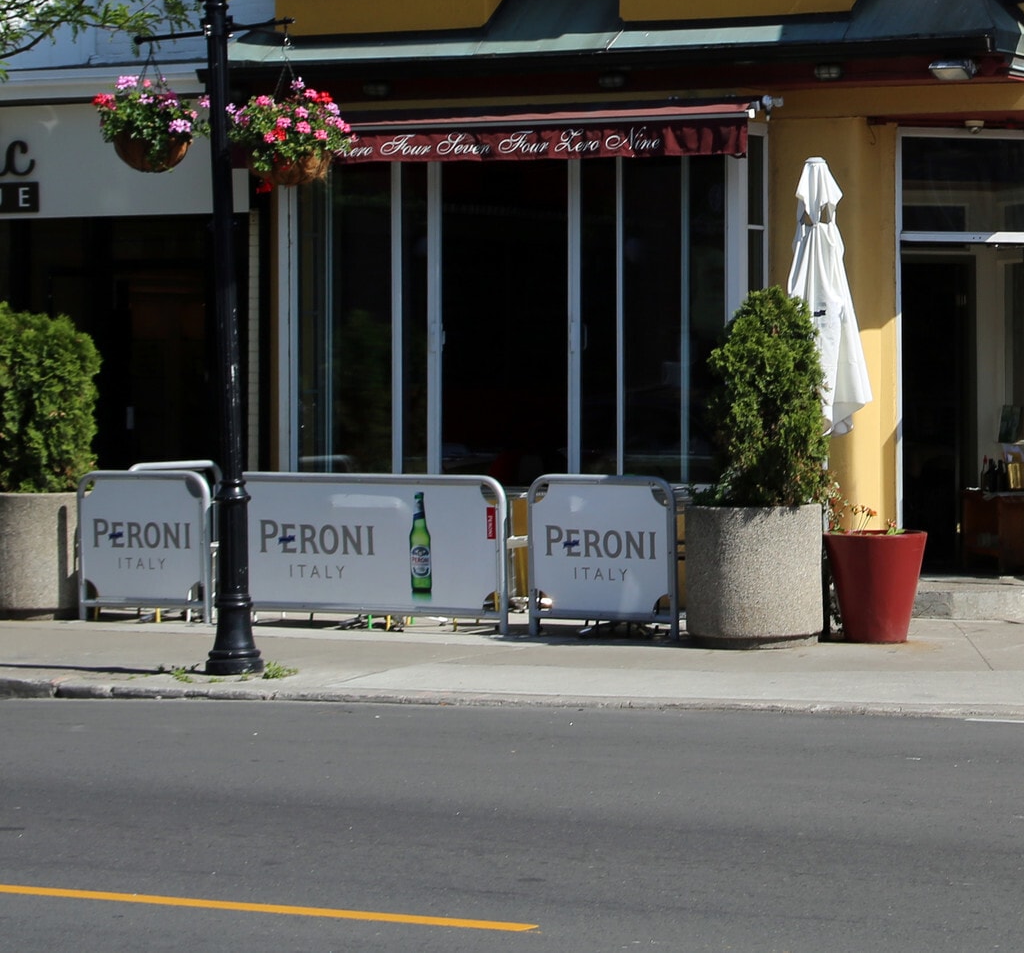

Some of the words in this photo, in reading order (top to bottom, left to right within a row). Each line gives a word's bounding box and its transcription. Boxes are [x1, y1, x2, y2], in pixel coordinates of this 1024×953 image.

[379, 133, 431, 157] Four
[436, 131, 491, 157] Seven
[498, 129, 550, 155] Four
[554, 127, 601, 153] Zero
[605, 126, 661, 152] Nine
[93, 518, 191, 549] PERONI
[258, 519, 375, 555] PERONI
[545, 524, 657, 560] PERONI
[118, 556, 166, 570] ITALY
[289, 563, 345, 579] ITALY
[573, 566, 628, 582] ITALY
